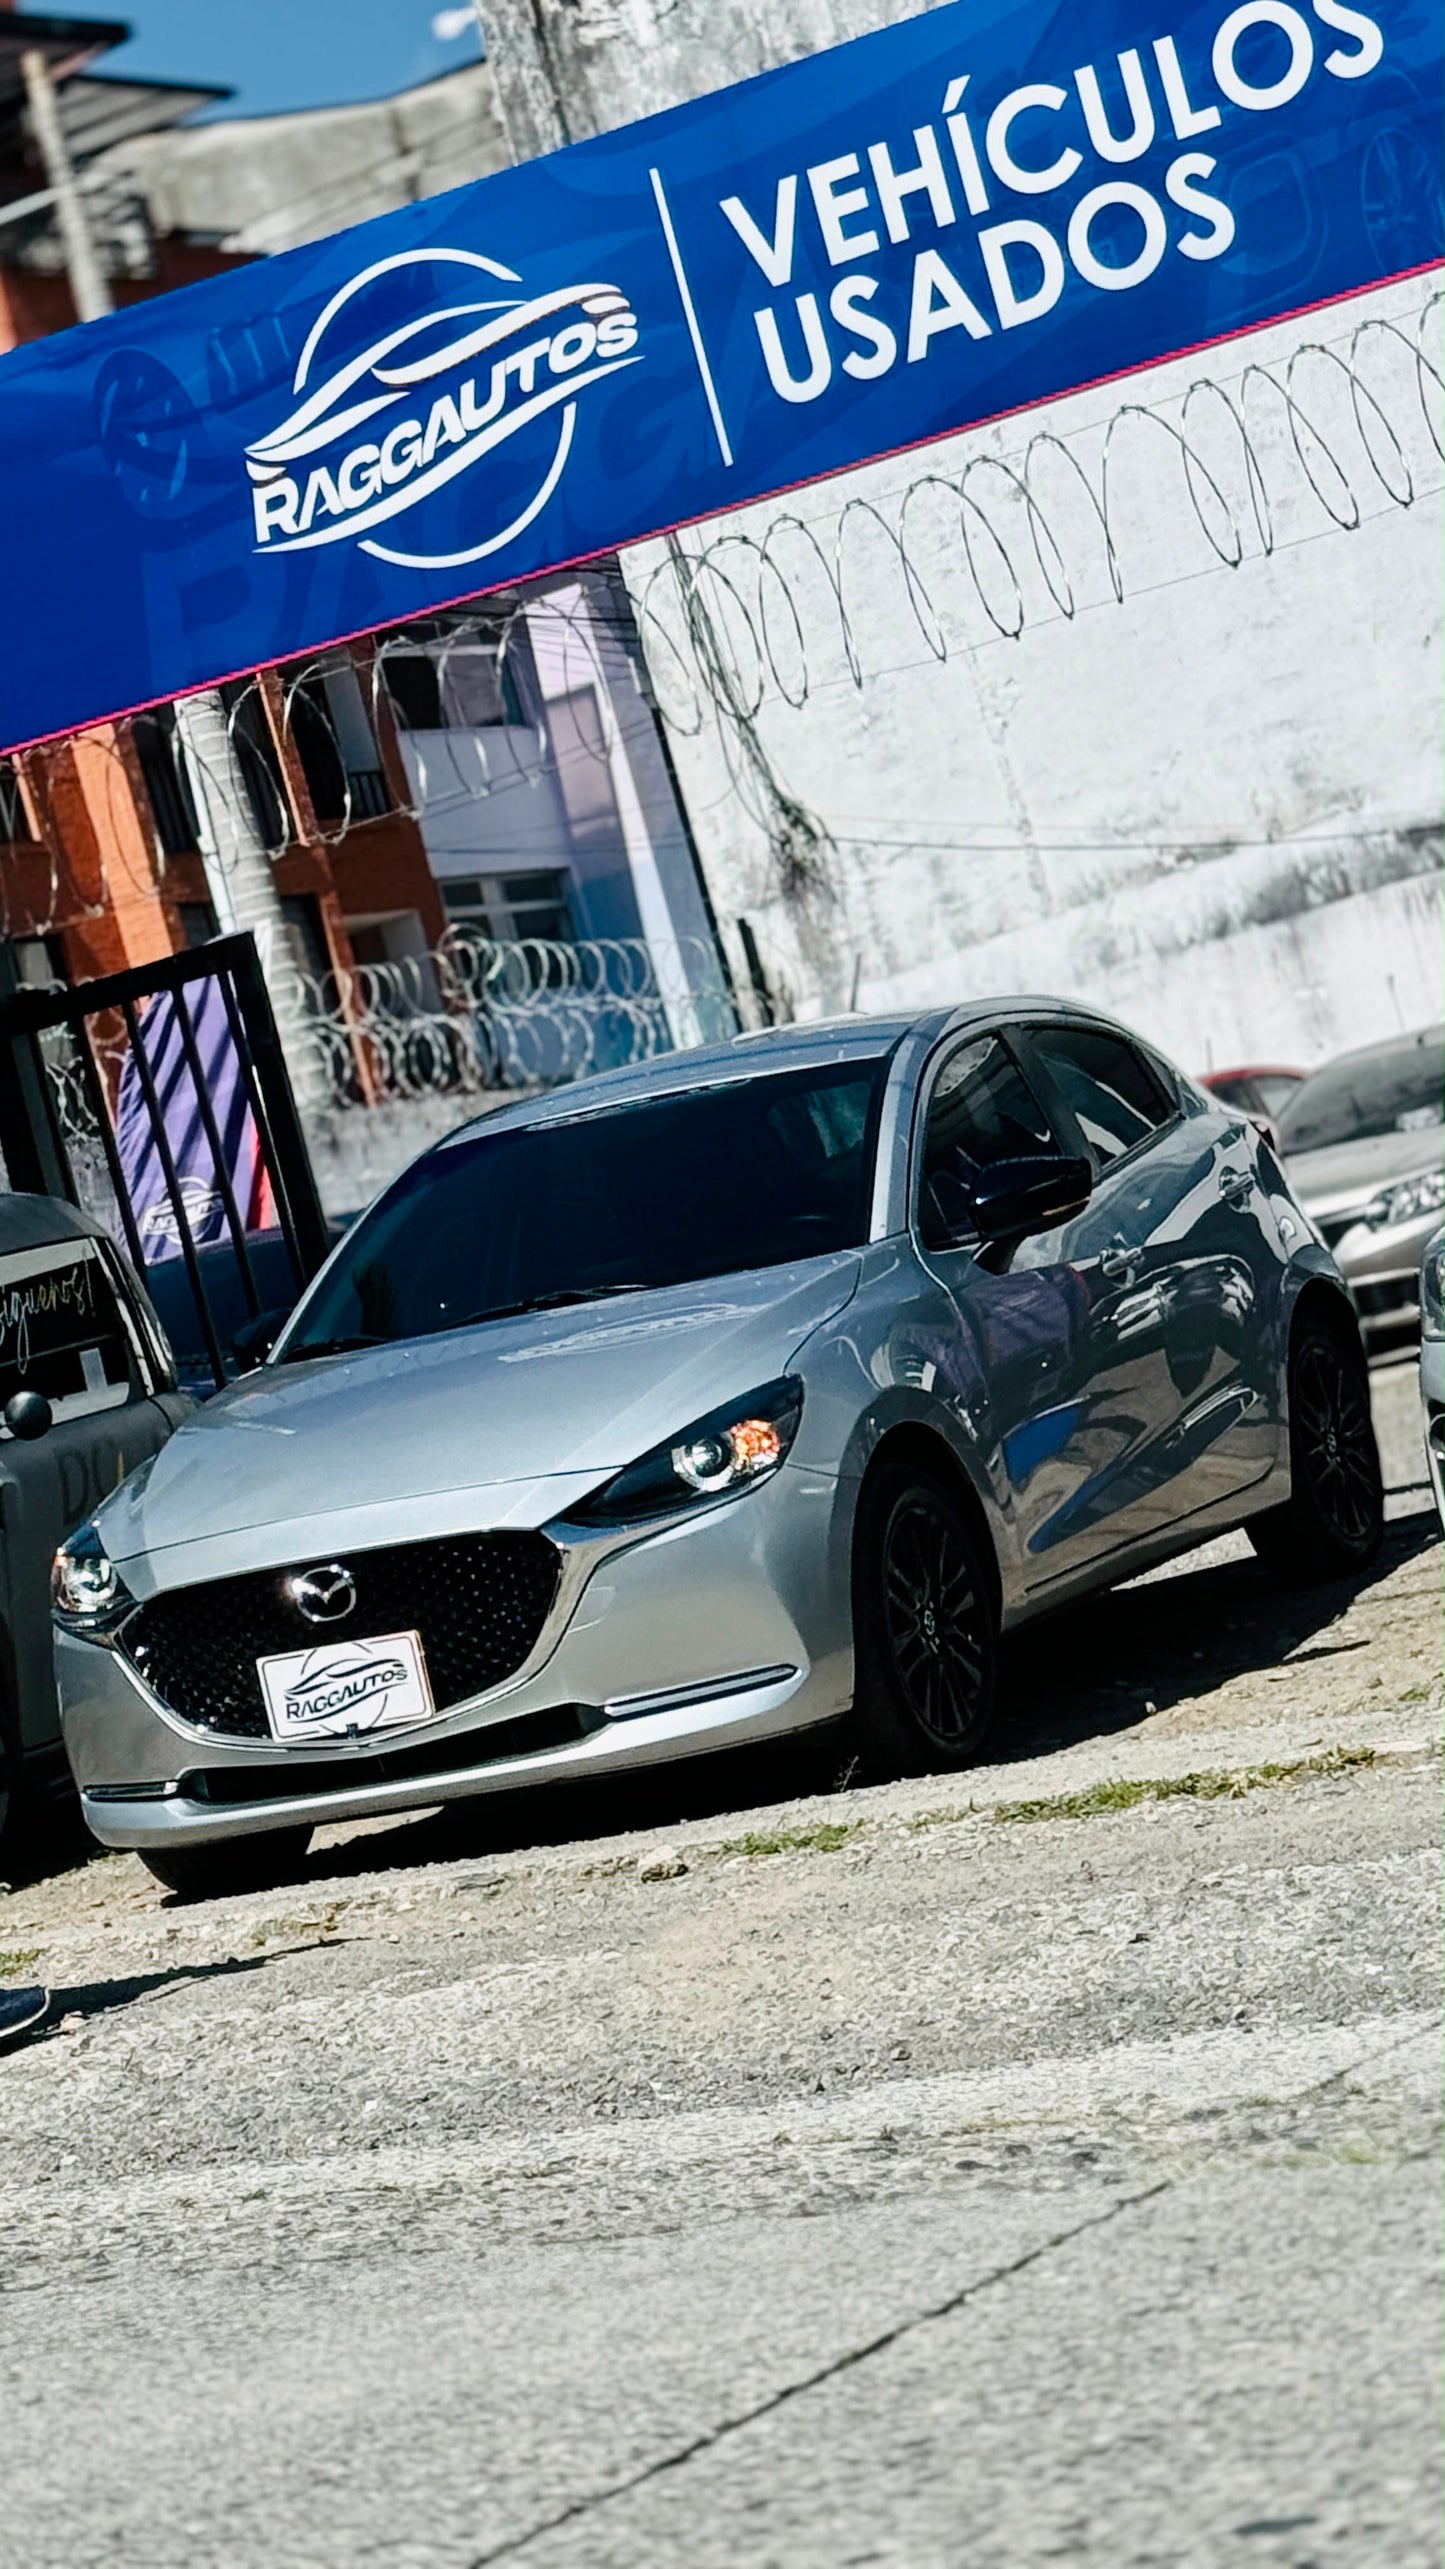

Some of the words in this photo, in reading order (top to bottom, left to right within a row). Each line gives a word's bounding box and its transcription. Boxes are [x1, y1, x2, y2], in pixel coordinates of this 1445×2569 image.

[719, 0, 1384, 288] VEHÍCULOS
[754, 152, 1236, 402] USADOS
[252, 312, 638, 543] RAGGAUTOS
[286, 1668, 408, 1720] RAGGAUTOS
